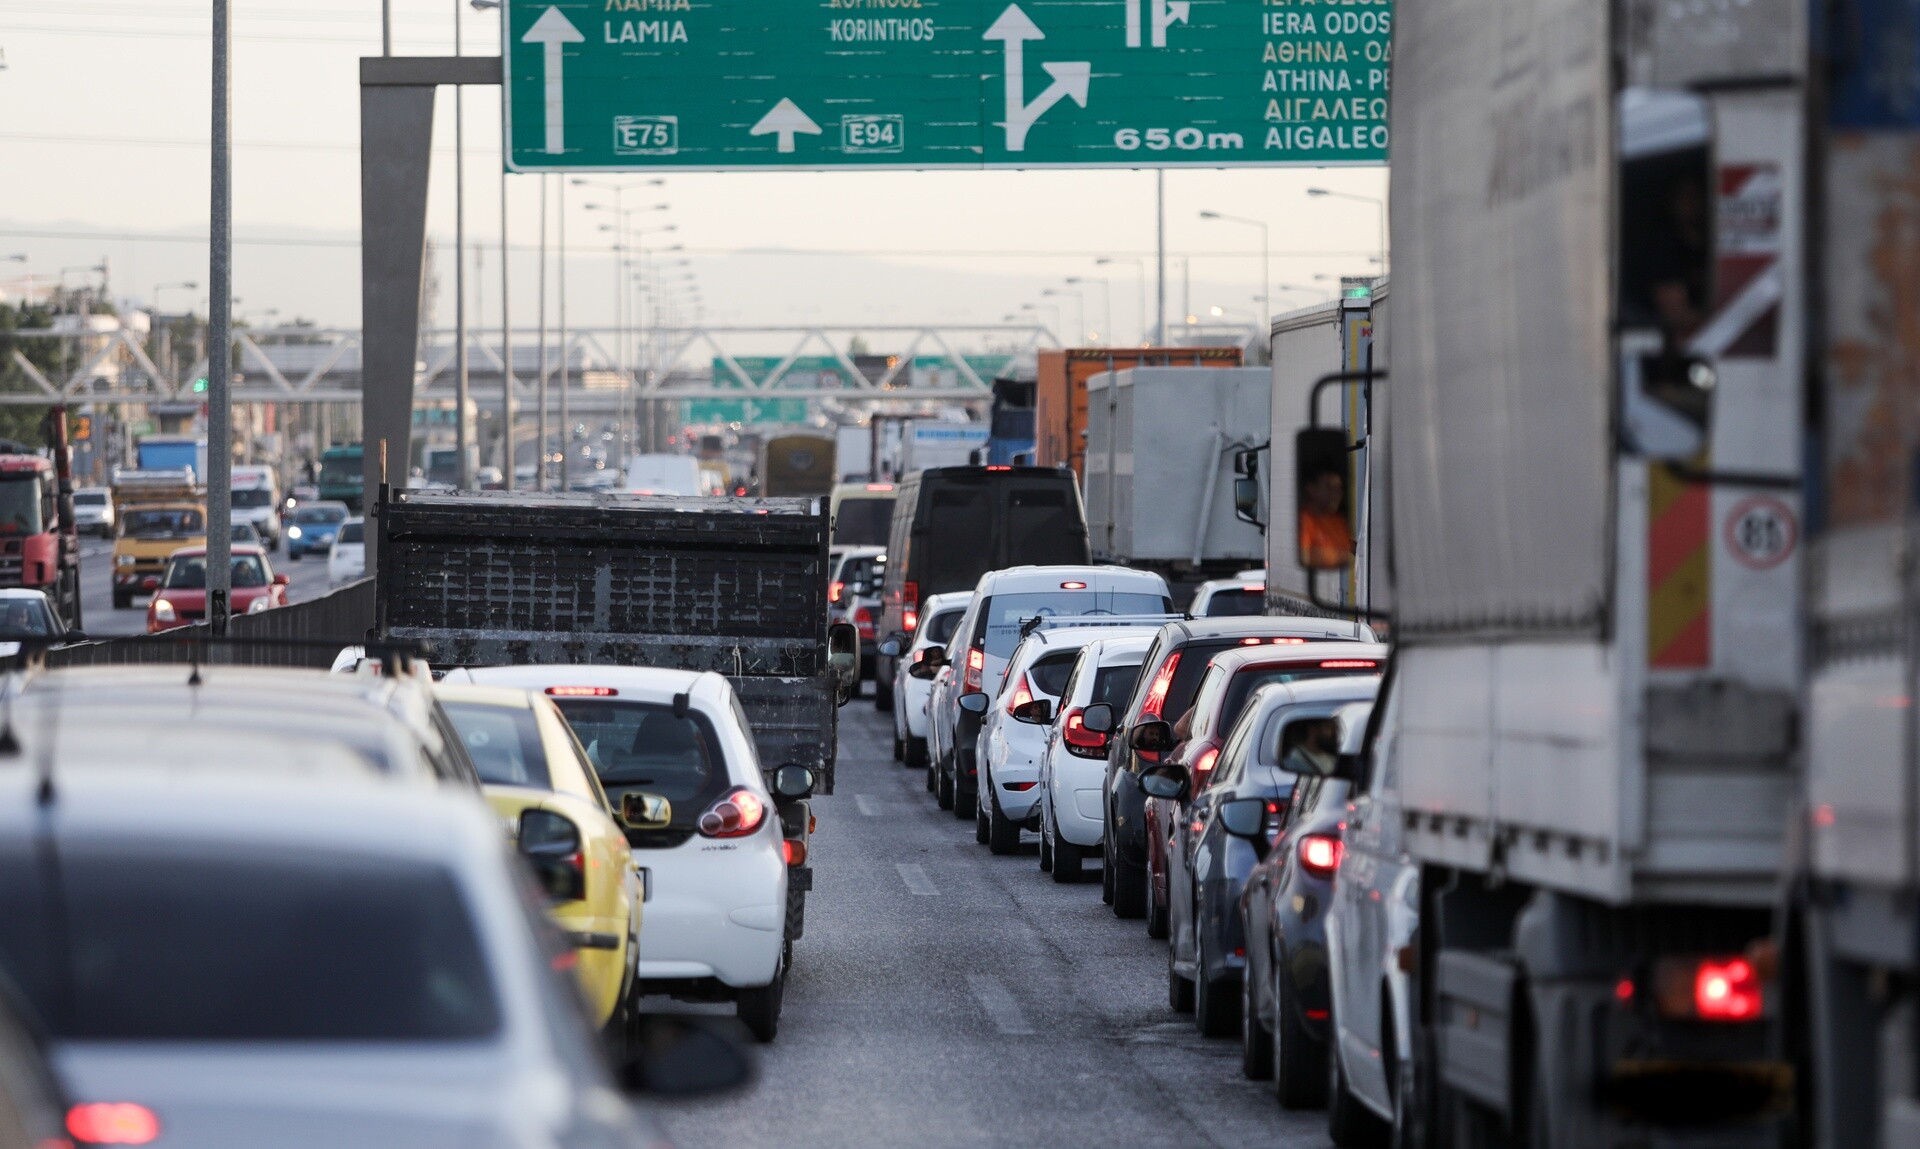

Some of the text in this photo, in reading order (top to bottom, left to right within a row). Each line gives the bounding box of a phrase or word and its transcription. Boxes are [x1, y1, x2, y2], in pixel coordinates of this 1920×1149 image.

[604, 21, 689, 43] LAMIA
[831, 18, 935, 42] KORINTHOS
[1263, 11, 1391, 35] IERA ODOS
[1262, 41, 1348, 63] ΑΘΗΝΑ
[1264, 98, 1388, 121] ΑΙΓΑΛΕΩ
[622, 124, 669, 147] E75
[849, 122, 895, 146] E94
[1114, 127, 1244, 150] 650m
[1264, 125, 1389, 150] AIGALEO
